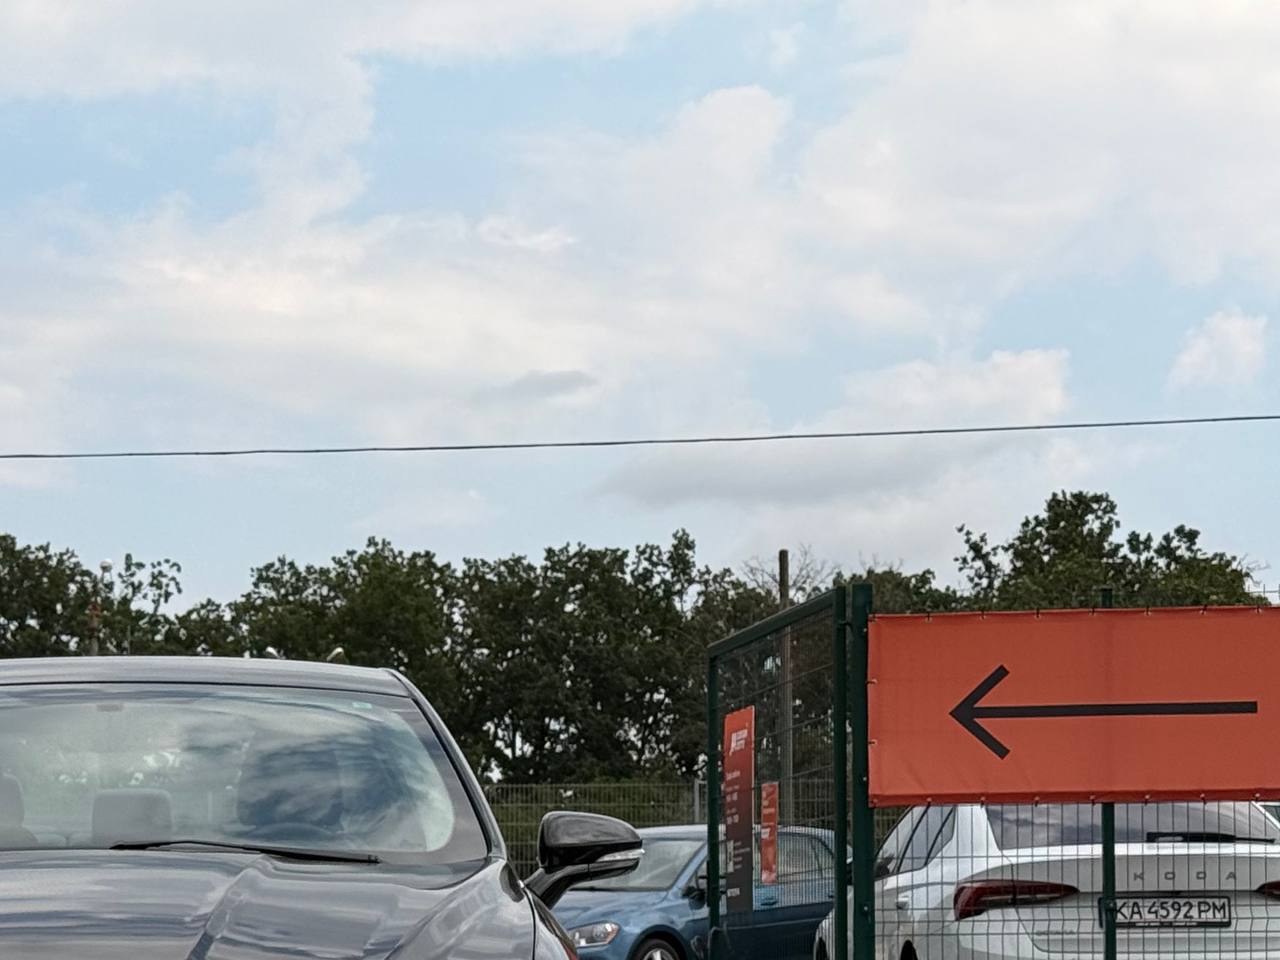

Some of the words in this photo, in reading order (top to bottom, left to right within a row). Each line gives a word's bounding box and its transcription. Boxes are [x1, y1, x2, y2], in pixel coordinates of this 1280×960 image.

[1133, 871, 1237, 881] KODA
[1147, 902, 1194, 920] 4592
[1198, 902, 1226, 919] PM
